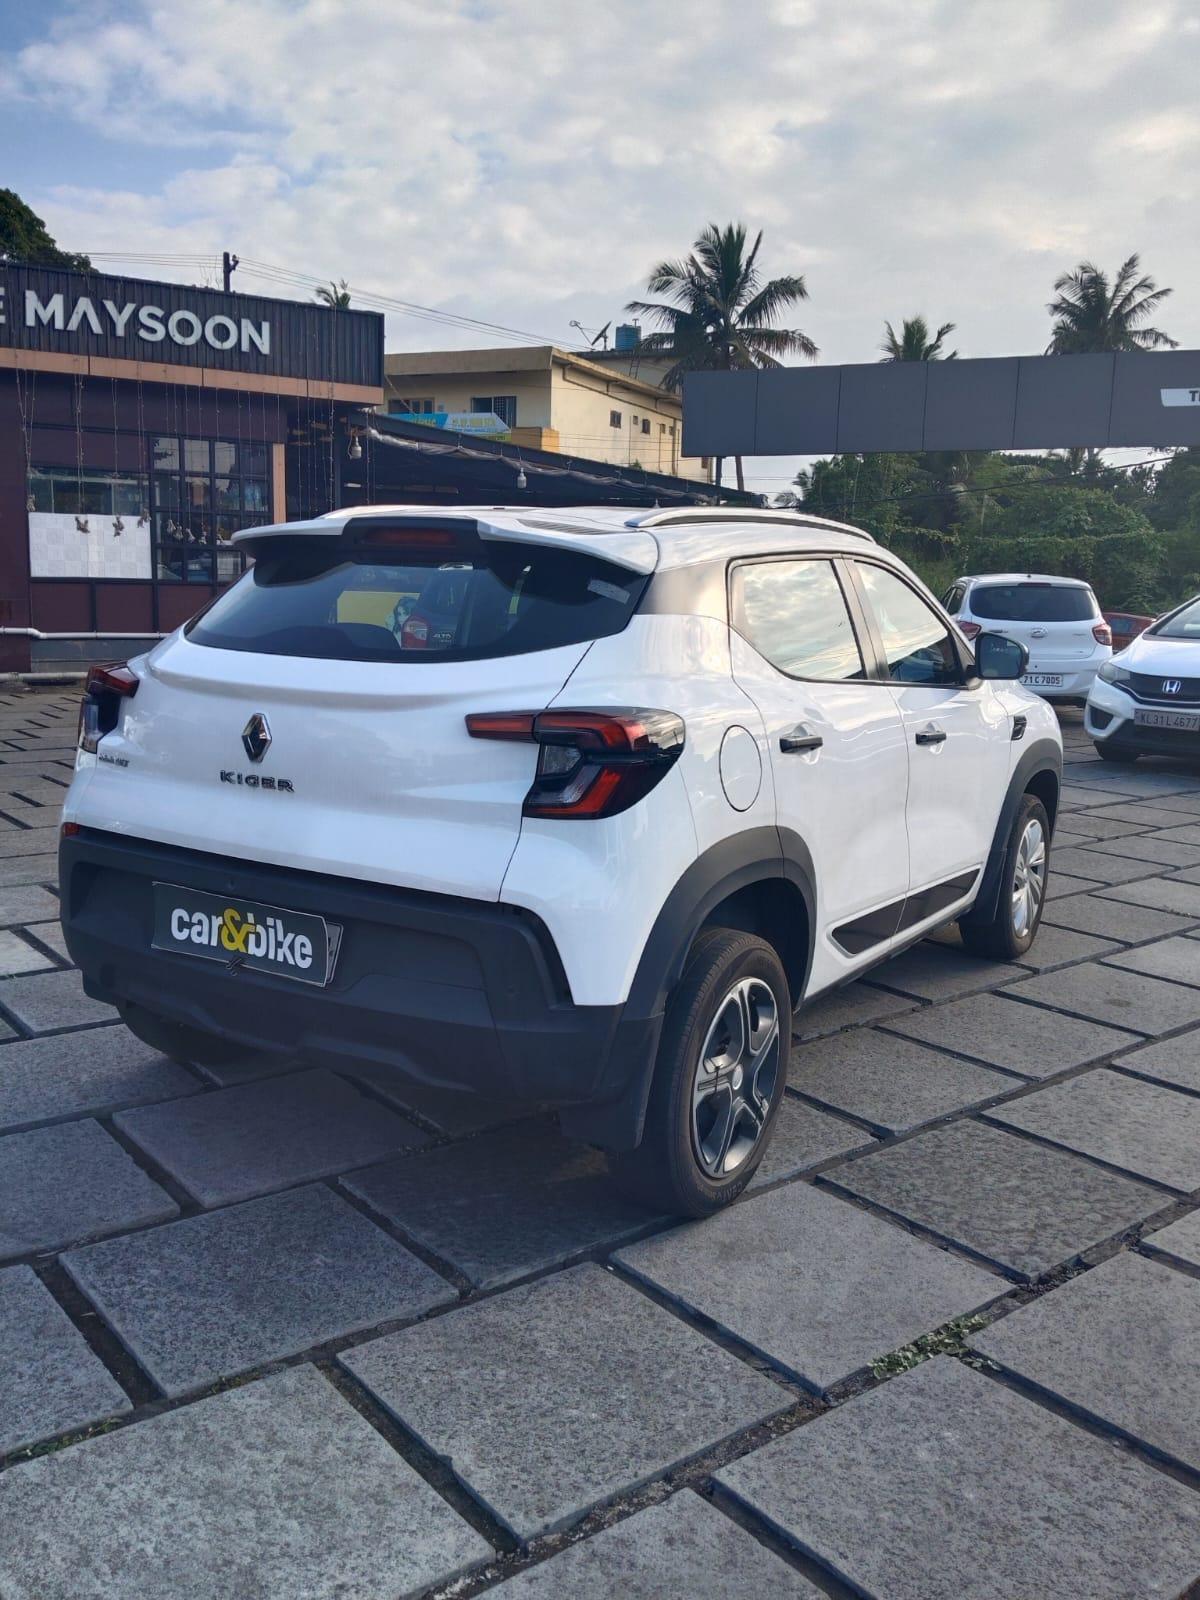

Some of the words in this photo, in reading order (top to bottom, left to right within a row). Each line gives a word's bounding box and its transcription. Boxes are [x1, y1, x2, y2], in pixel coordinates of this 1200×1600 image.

[25, 290, 270, 355] MAYSOON
[1189, 390, 1200, 402] T
[219, 770, 295, 793] KIGER
[171, 908, 313, 969] car&bike
